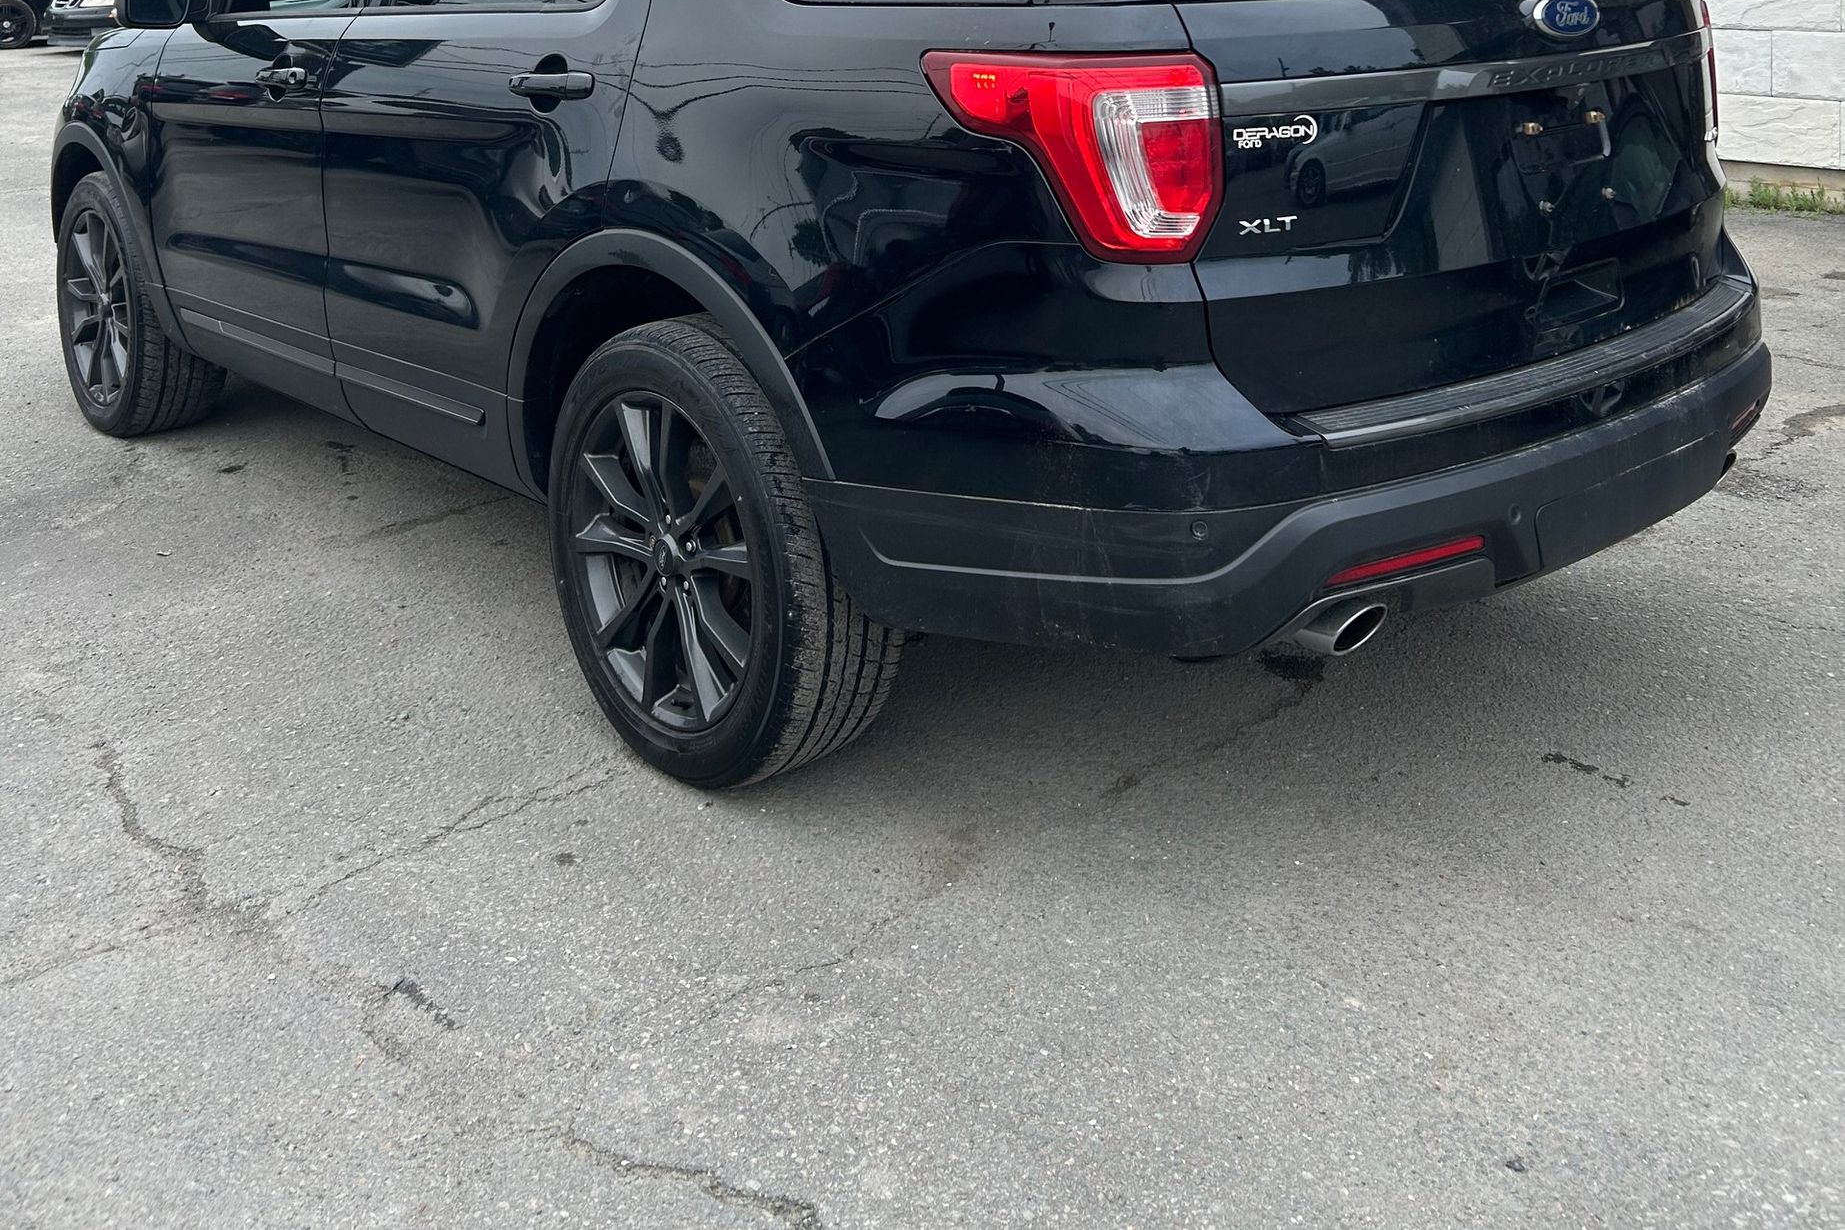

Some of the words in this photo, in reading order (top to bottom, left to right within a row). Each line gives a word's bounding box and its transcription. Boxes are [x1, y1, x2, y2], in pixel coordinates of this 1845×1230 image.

[1556, 1, 1590, 27] Ford
[1233, 124, 1314, 141] DERAGON
[1238, 139, 1262, 148] FORD
[1239, 216, 1298, 235] XLT
